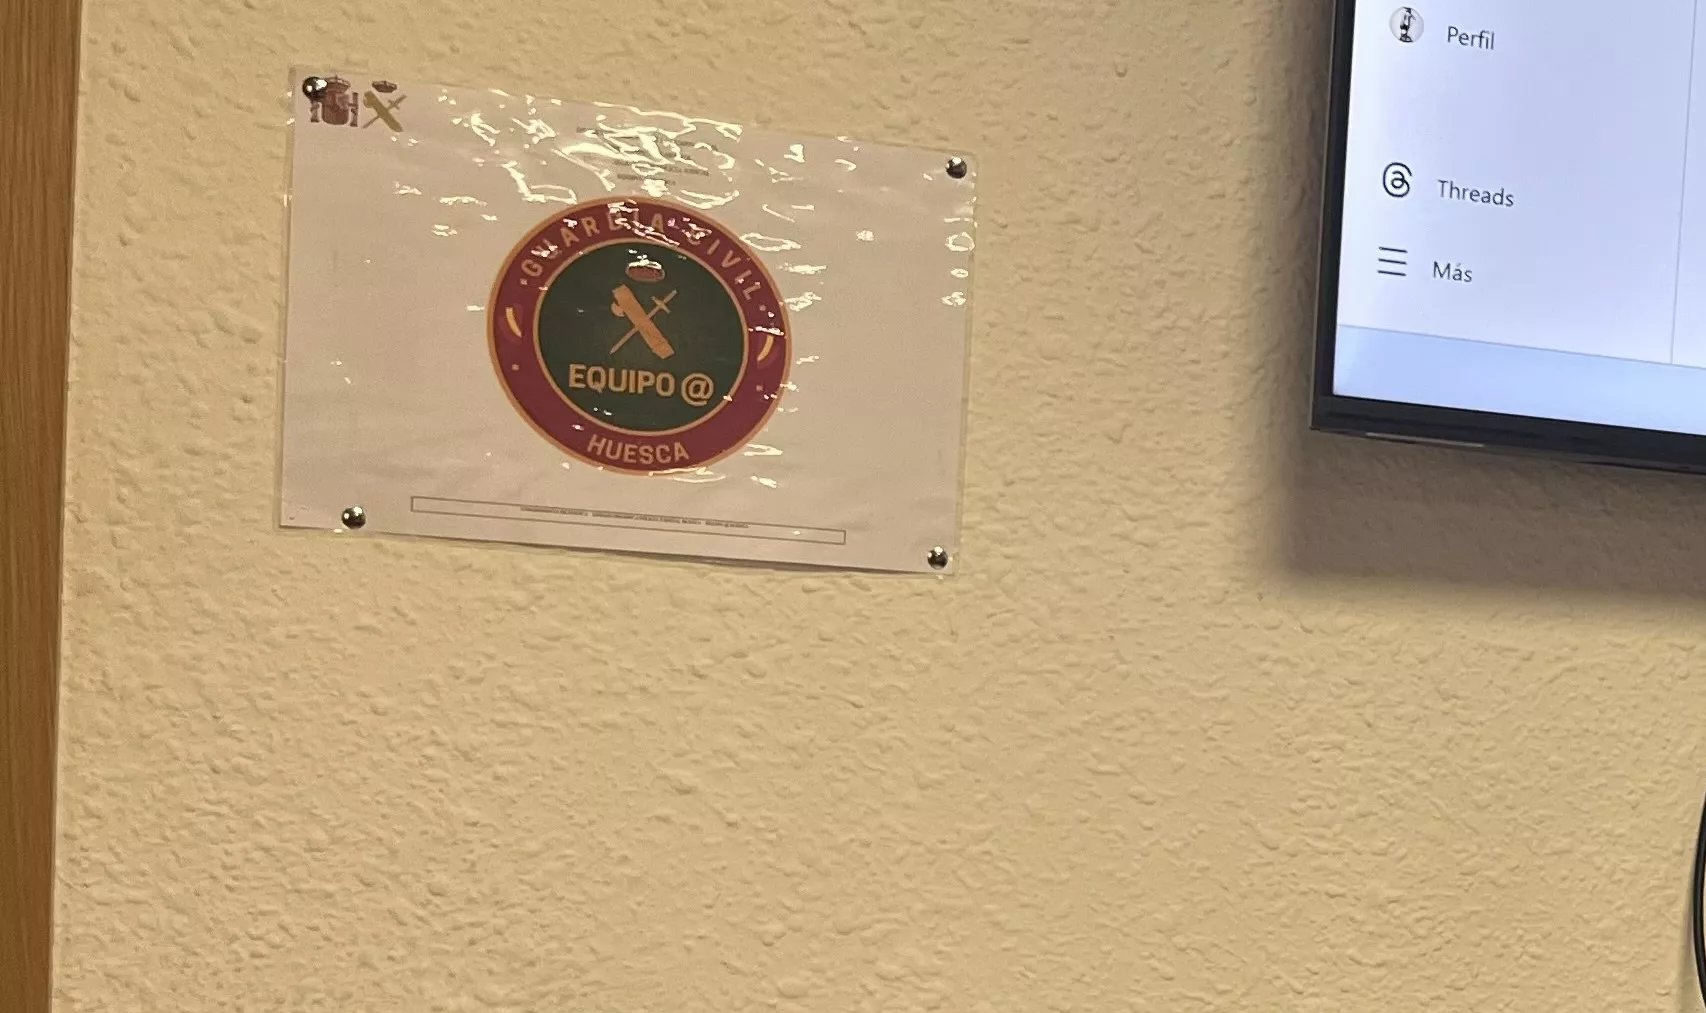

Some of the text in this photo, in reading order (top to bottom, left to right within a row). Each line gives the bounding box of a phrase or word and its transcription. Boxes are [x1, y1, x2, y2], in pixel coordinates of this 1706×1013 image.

[1447, 26, 1495, 50] Perfil
[1437, 179, 1515, 207] Threads
[520, 208, 665, 278] GUARDIA
[1432, 260, 1473, 283] Más
[568, 363, 714, 407] EQUIPO @
[586, 433, 690, 465] HUESCA
